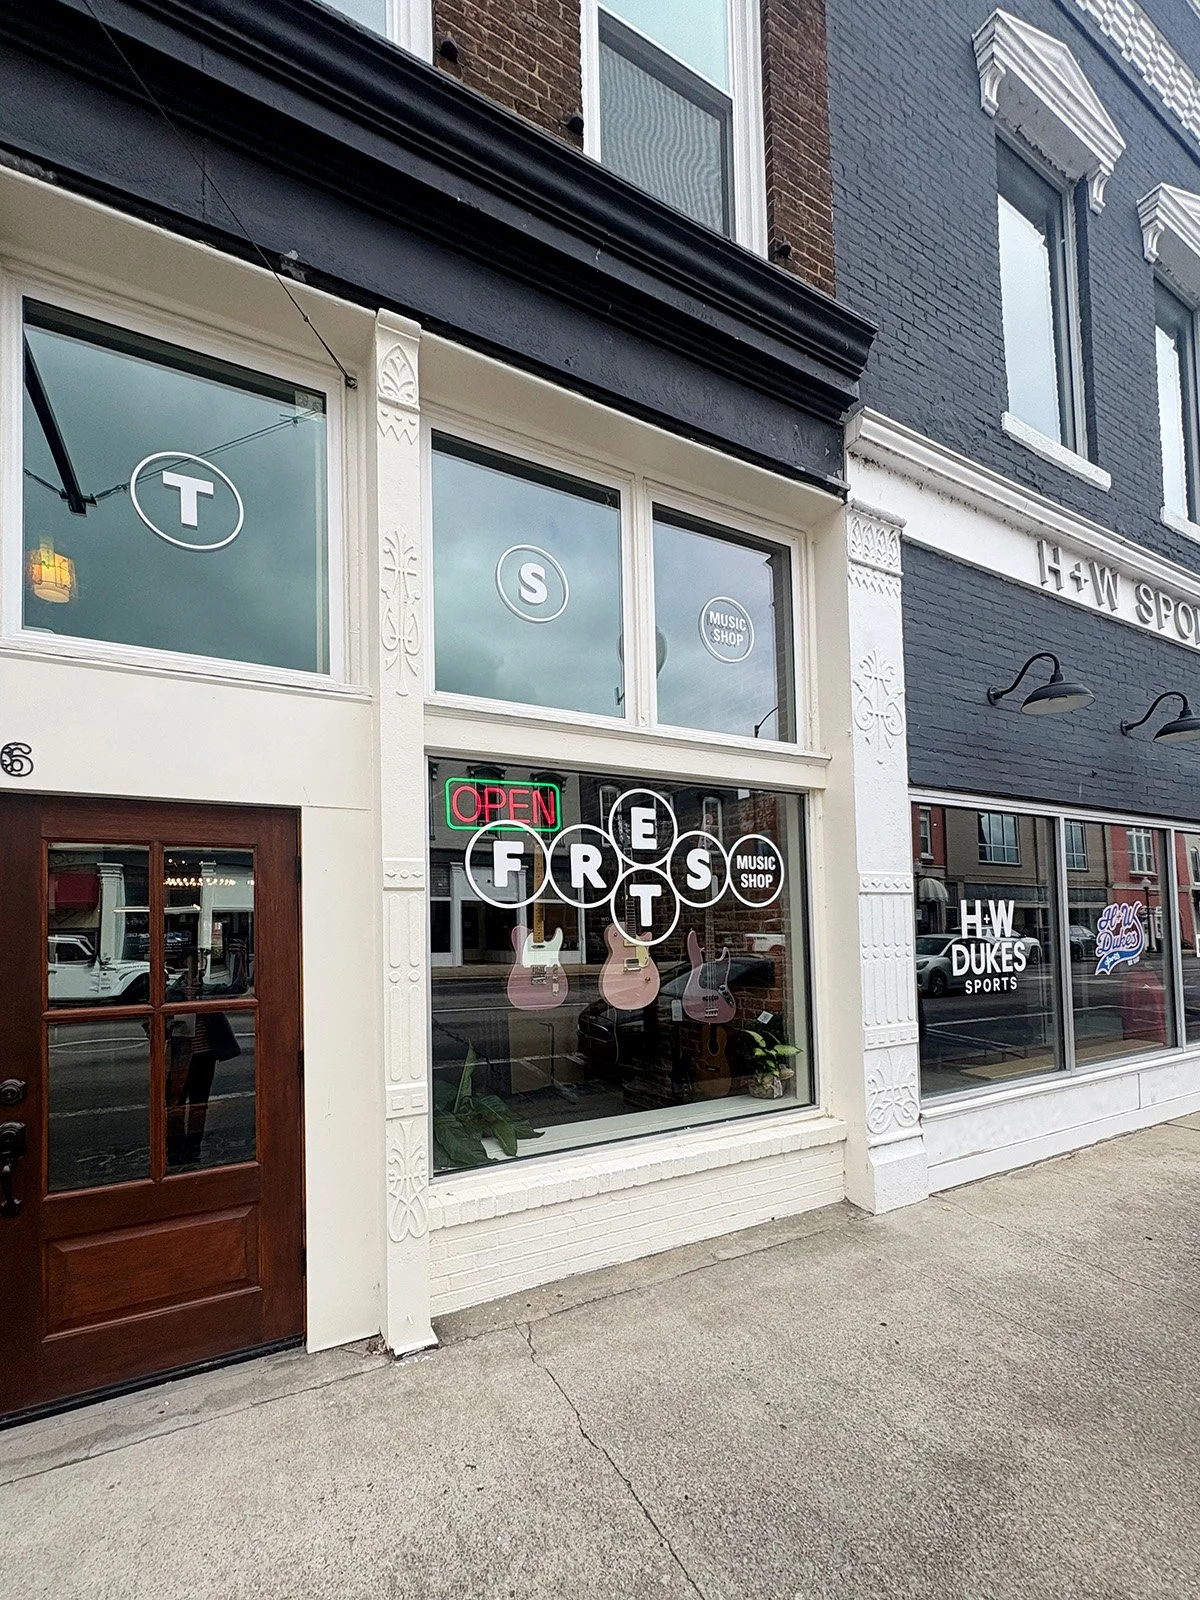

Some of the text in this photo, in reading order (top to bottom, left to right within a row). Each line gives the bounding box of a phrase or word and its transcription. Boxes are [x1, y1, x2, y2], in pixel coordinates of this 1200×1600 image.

[162, 470, 214, 528] T
[519, 562, 548, 604] S
[1037, 540, 1120, 612] H+W
[708, 610, 747, 632] MUSIC
[712, 628, 744, 647] SHOP
[452, 785, 556, 825] OPEN
[736, 855, 776, 871] MUSIC
[740, 873, 774, 889] SHOP
[951, 941, 1027, 977] DUKES
[965, 976, 1018, 994] SPORTS
